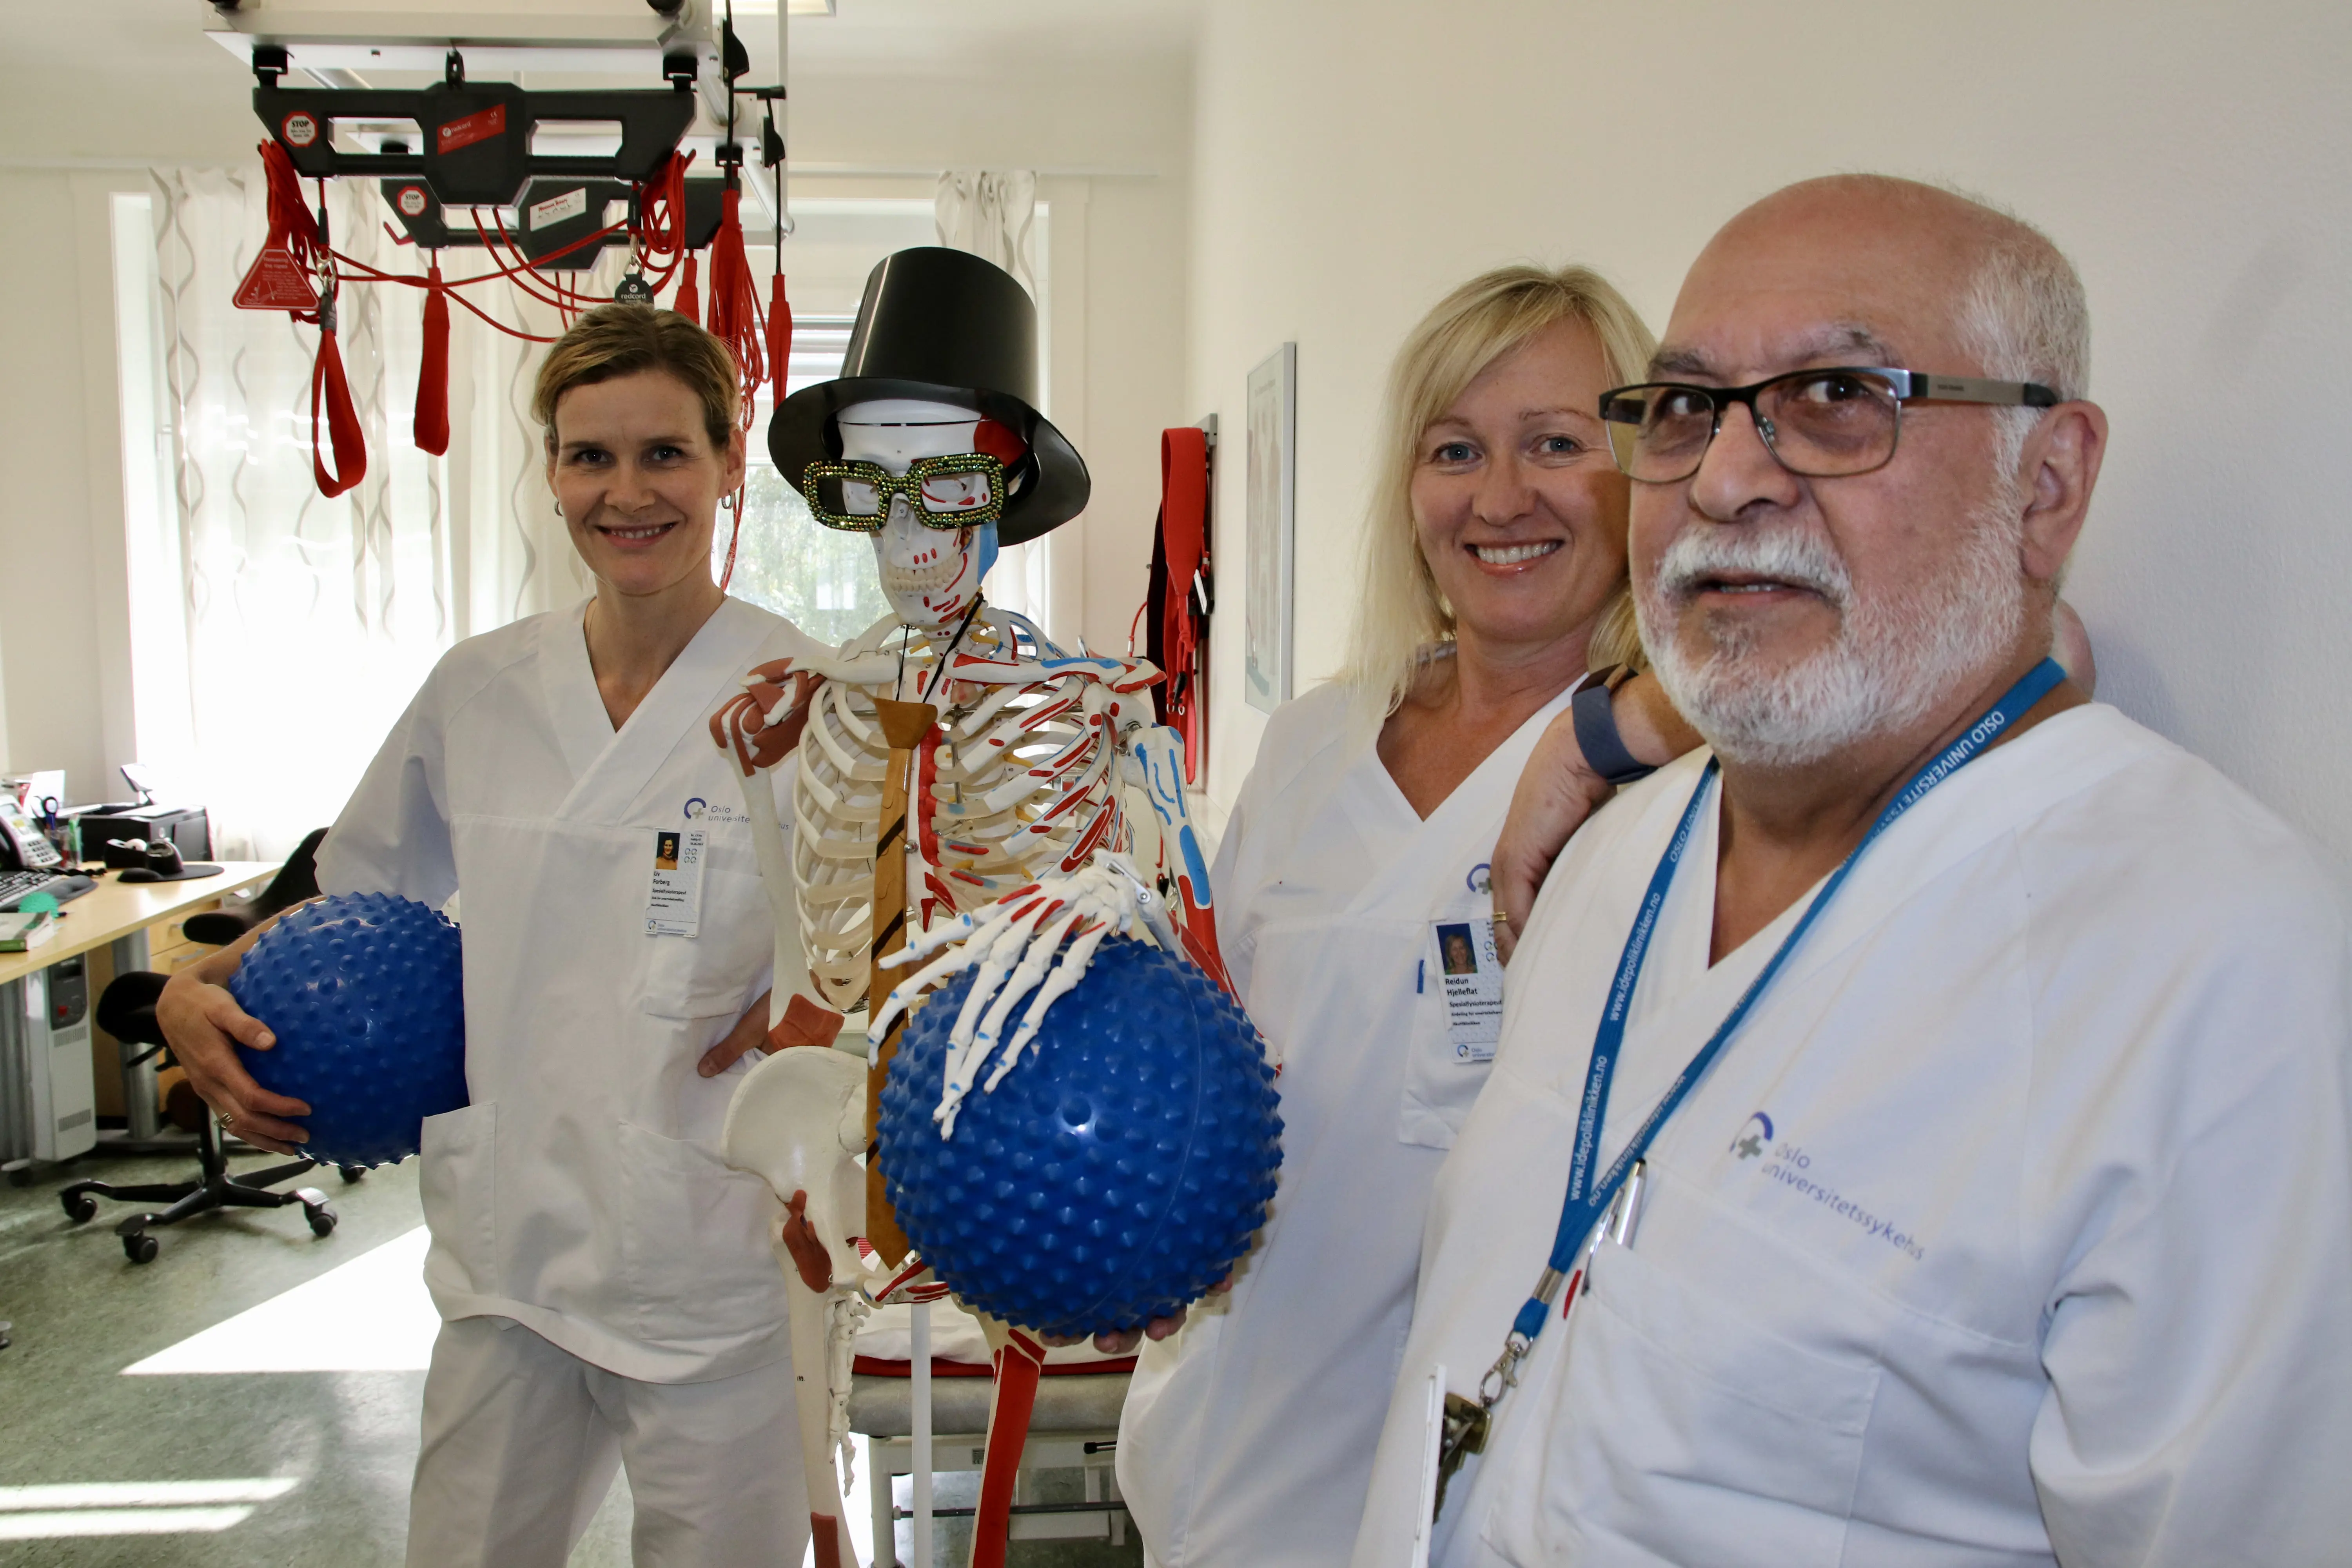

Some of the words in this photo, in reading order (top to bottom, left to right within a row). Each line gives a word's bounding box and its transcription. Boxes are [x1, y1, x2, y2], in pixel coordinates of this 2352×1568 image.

[1971, 711, 2005, 743] OSLO
[1670, 830, 1687, 863] OSLO
[1610, 892, 1661, 1021] www.idepoliklinikken.no
[1447, 988, 1478, 997] Hjelleflat
[1450, 999, 1502, 1008] Spesialfysioterapeut
[1571, 1055, 1607, 1200] www.idepoliklinikken.no
